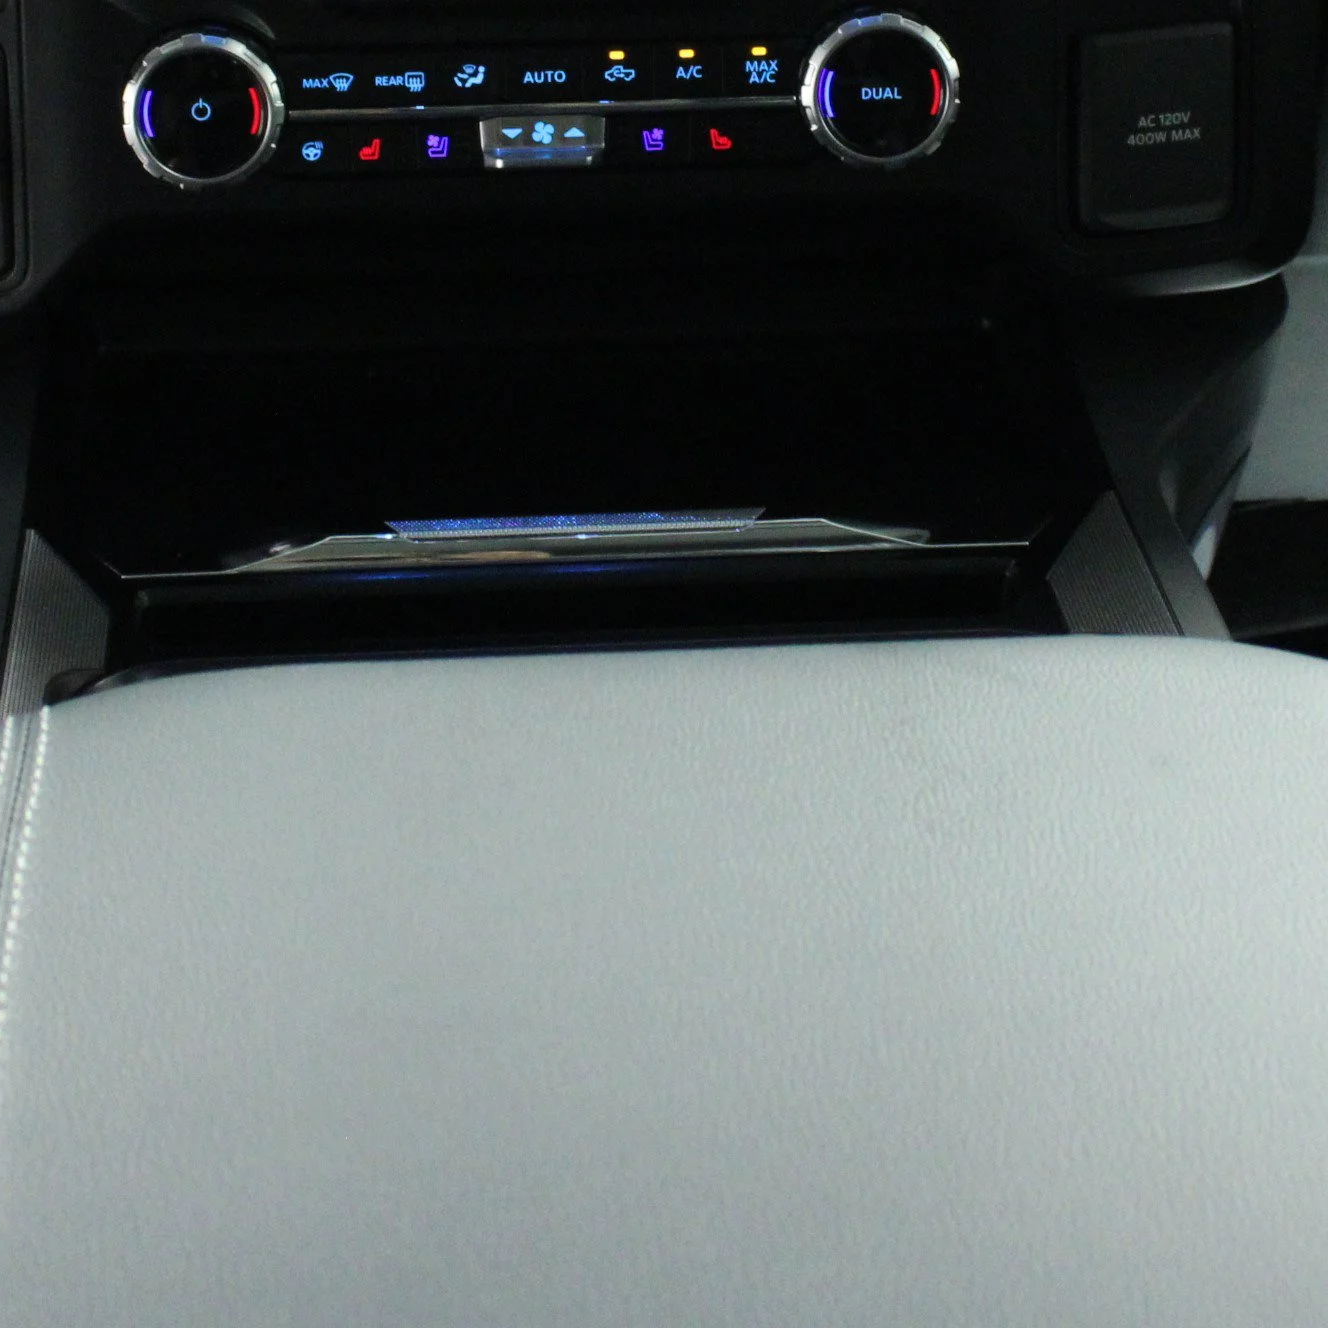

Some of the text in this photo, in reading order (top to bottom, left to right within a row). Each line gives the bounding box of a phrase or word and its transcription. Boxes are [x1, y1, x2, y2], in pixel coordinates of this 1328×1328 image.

[676, 65, 703, 80] A/C
[745, 60, 779, 73] MAX
[302, 78, 329, 89] MAX
[375, 75, 404, 87] REAR
[523, 70, 567, 84] AUTO
[749, 71, 776, 85] A/C
[861, 86, 903, 101] DUAL
[1158, 111, 1191, 127] 120V
[1127, 127, 1201, 147] 400W MAX
